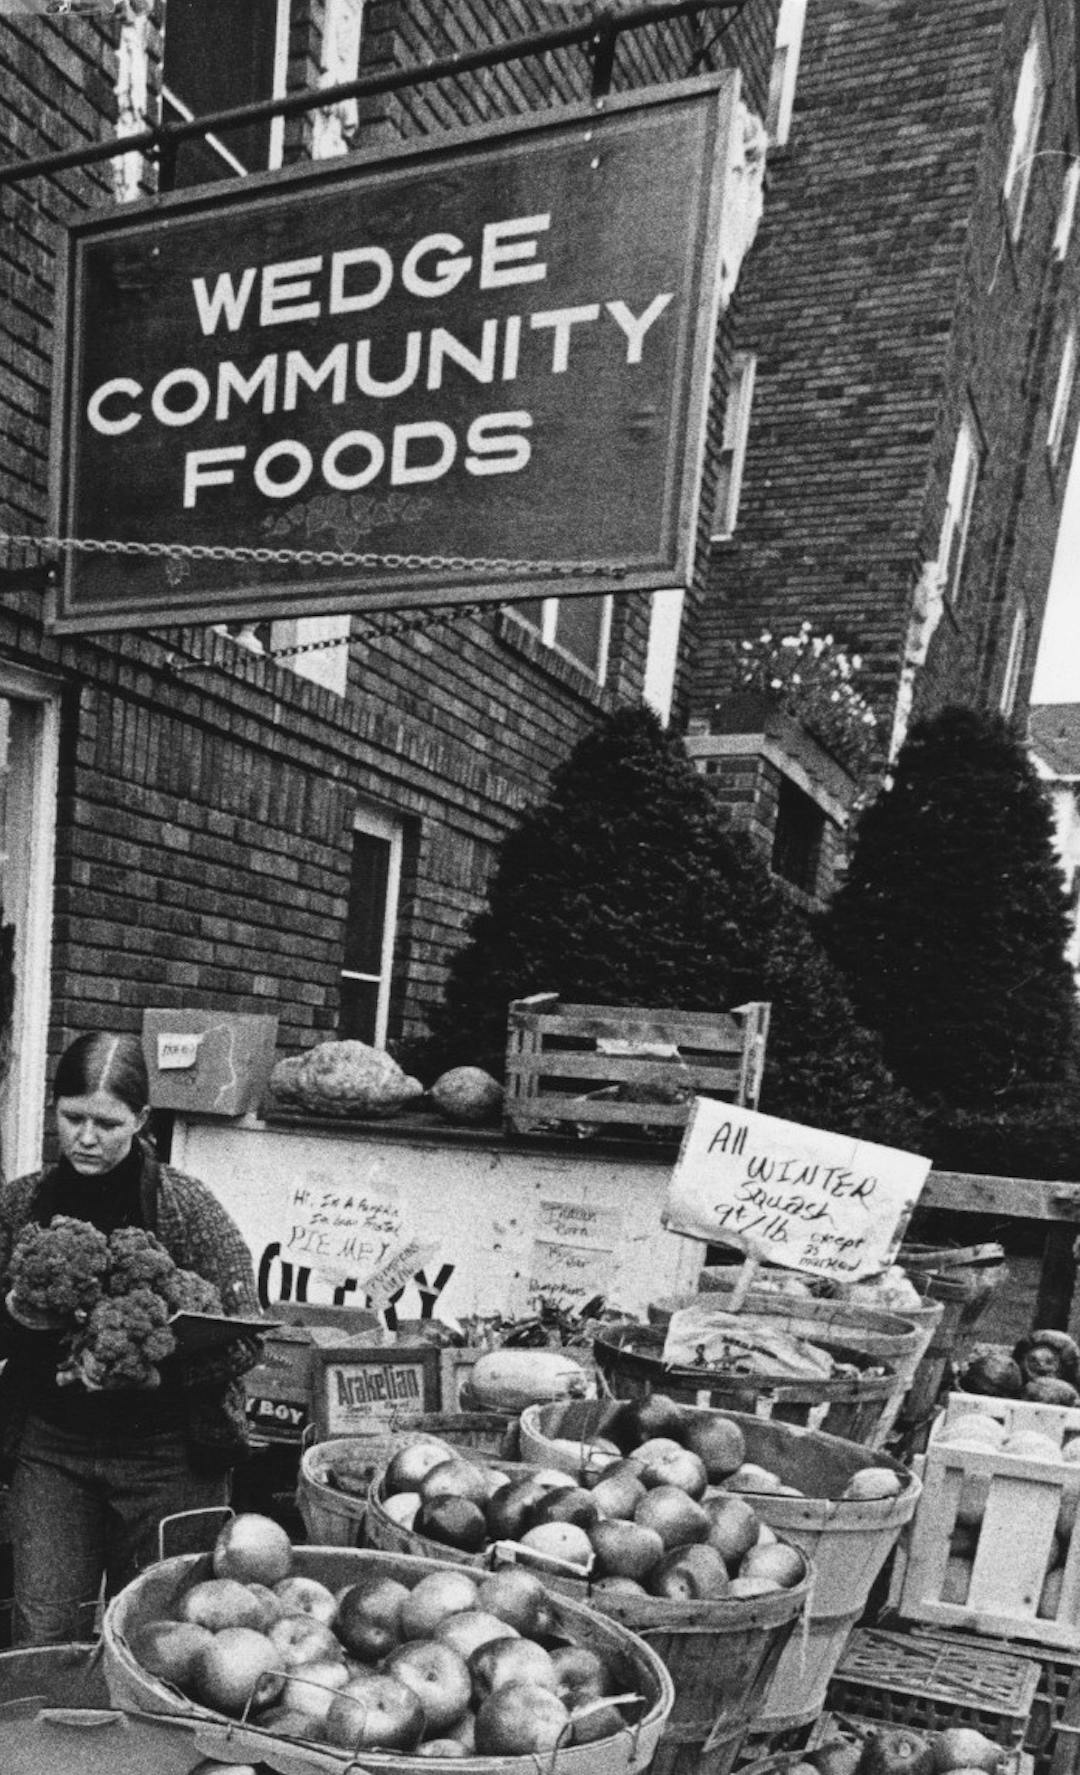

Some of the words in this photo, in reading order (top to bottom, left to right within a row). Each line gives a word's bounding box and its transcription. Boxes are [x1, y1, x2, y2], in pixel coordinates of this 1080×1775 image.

[191, 212, 551, 337] WEDGE
[86, 292, 675, 436] COMMUNITY
[182, 410, 533, 508] FOODS
[707, 1121, 749, 1156] All
[747, 1155, 876, 1210] WINTER
[259, 1399, 304, 1425] BOY
[335, 1365, 420, 1406] Arakelian
